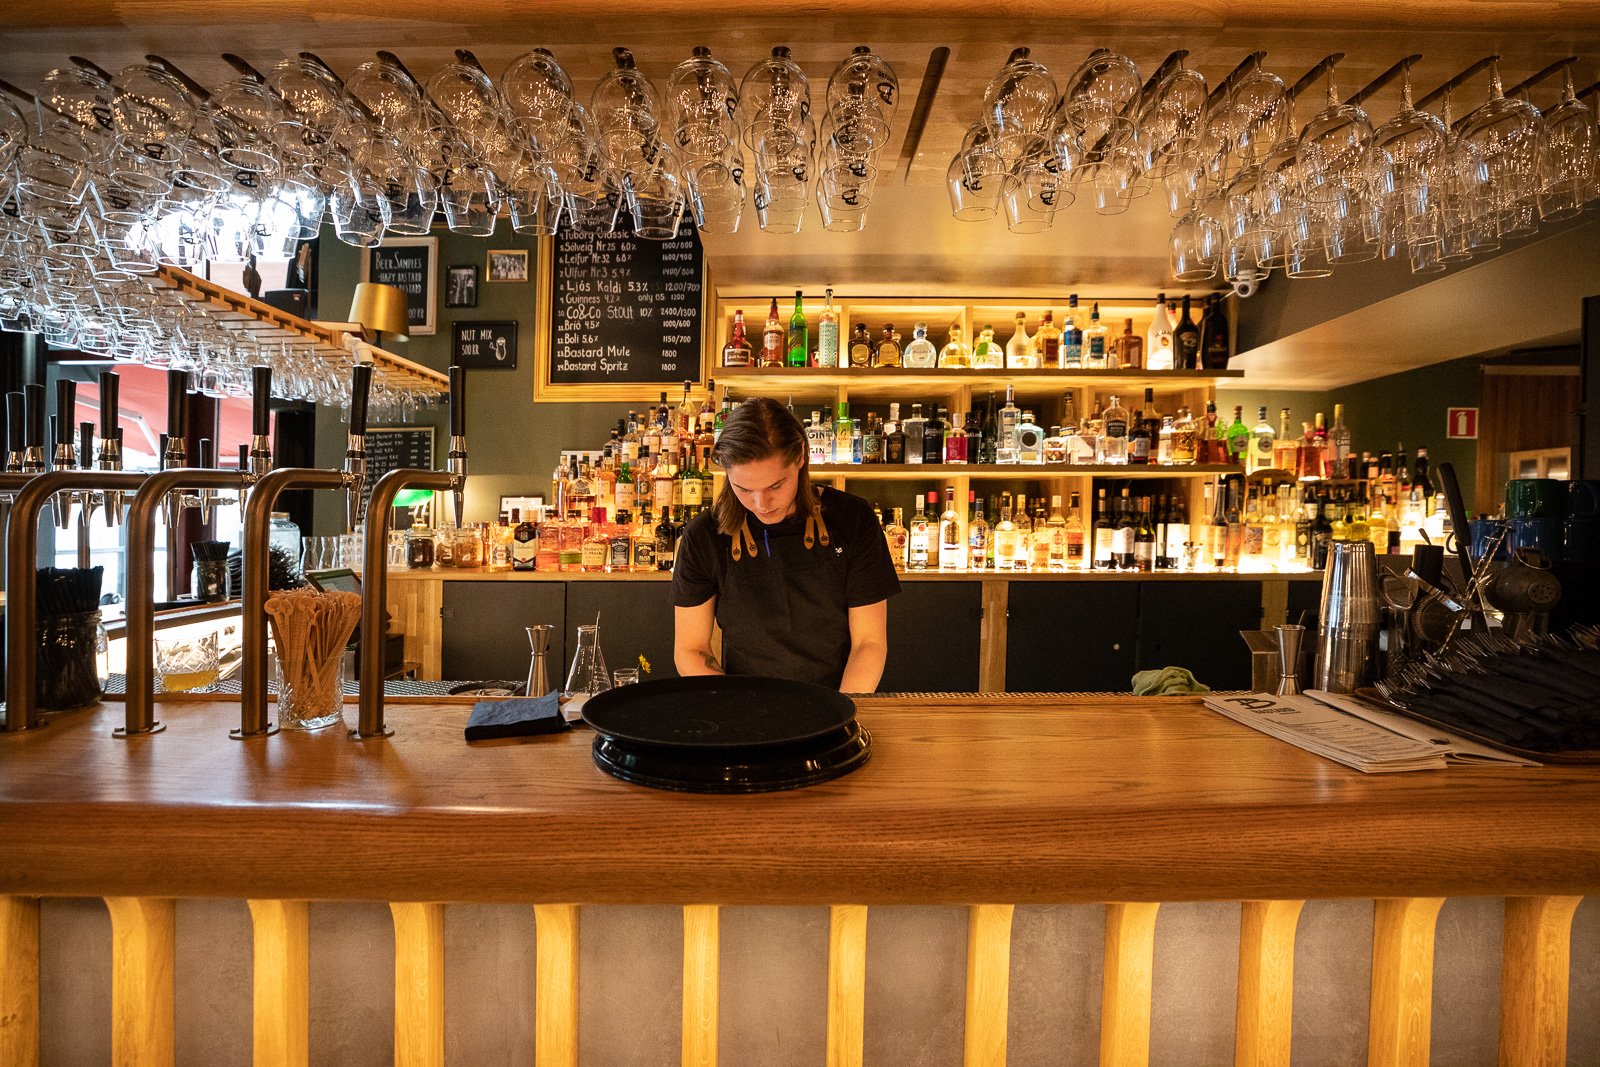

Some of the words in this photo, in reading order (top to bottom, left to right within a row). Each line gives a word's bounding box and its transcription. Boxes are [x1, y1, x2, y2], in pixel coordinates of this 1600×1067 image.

[597, 280, 622, 293] Kaldi
[628, 282, 648, 291] 5.3%
[566, 293, 600, 304] Guinness
[638, 294, 653, 303] only
[566, 304, 601, 320] Co&Co
[640, 308, 652, 317] 10%
[661, 307, 696, 317] 2400/1300
[663, 320, 690, 329] 1000/600
[462, 329, 476, 341] NUT
[480, 329, 492, 340] MIX
[565, 333, 579, 344] Boli
[663, 335, 691, 345] 1150/700
[564, 346, 603, 357] Bastard
[607, 345, 630, 357] Mule
[564, 360, 596, 371] Bastard
[600, 358, 628, 374] Spritz
